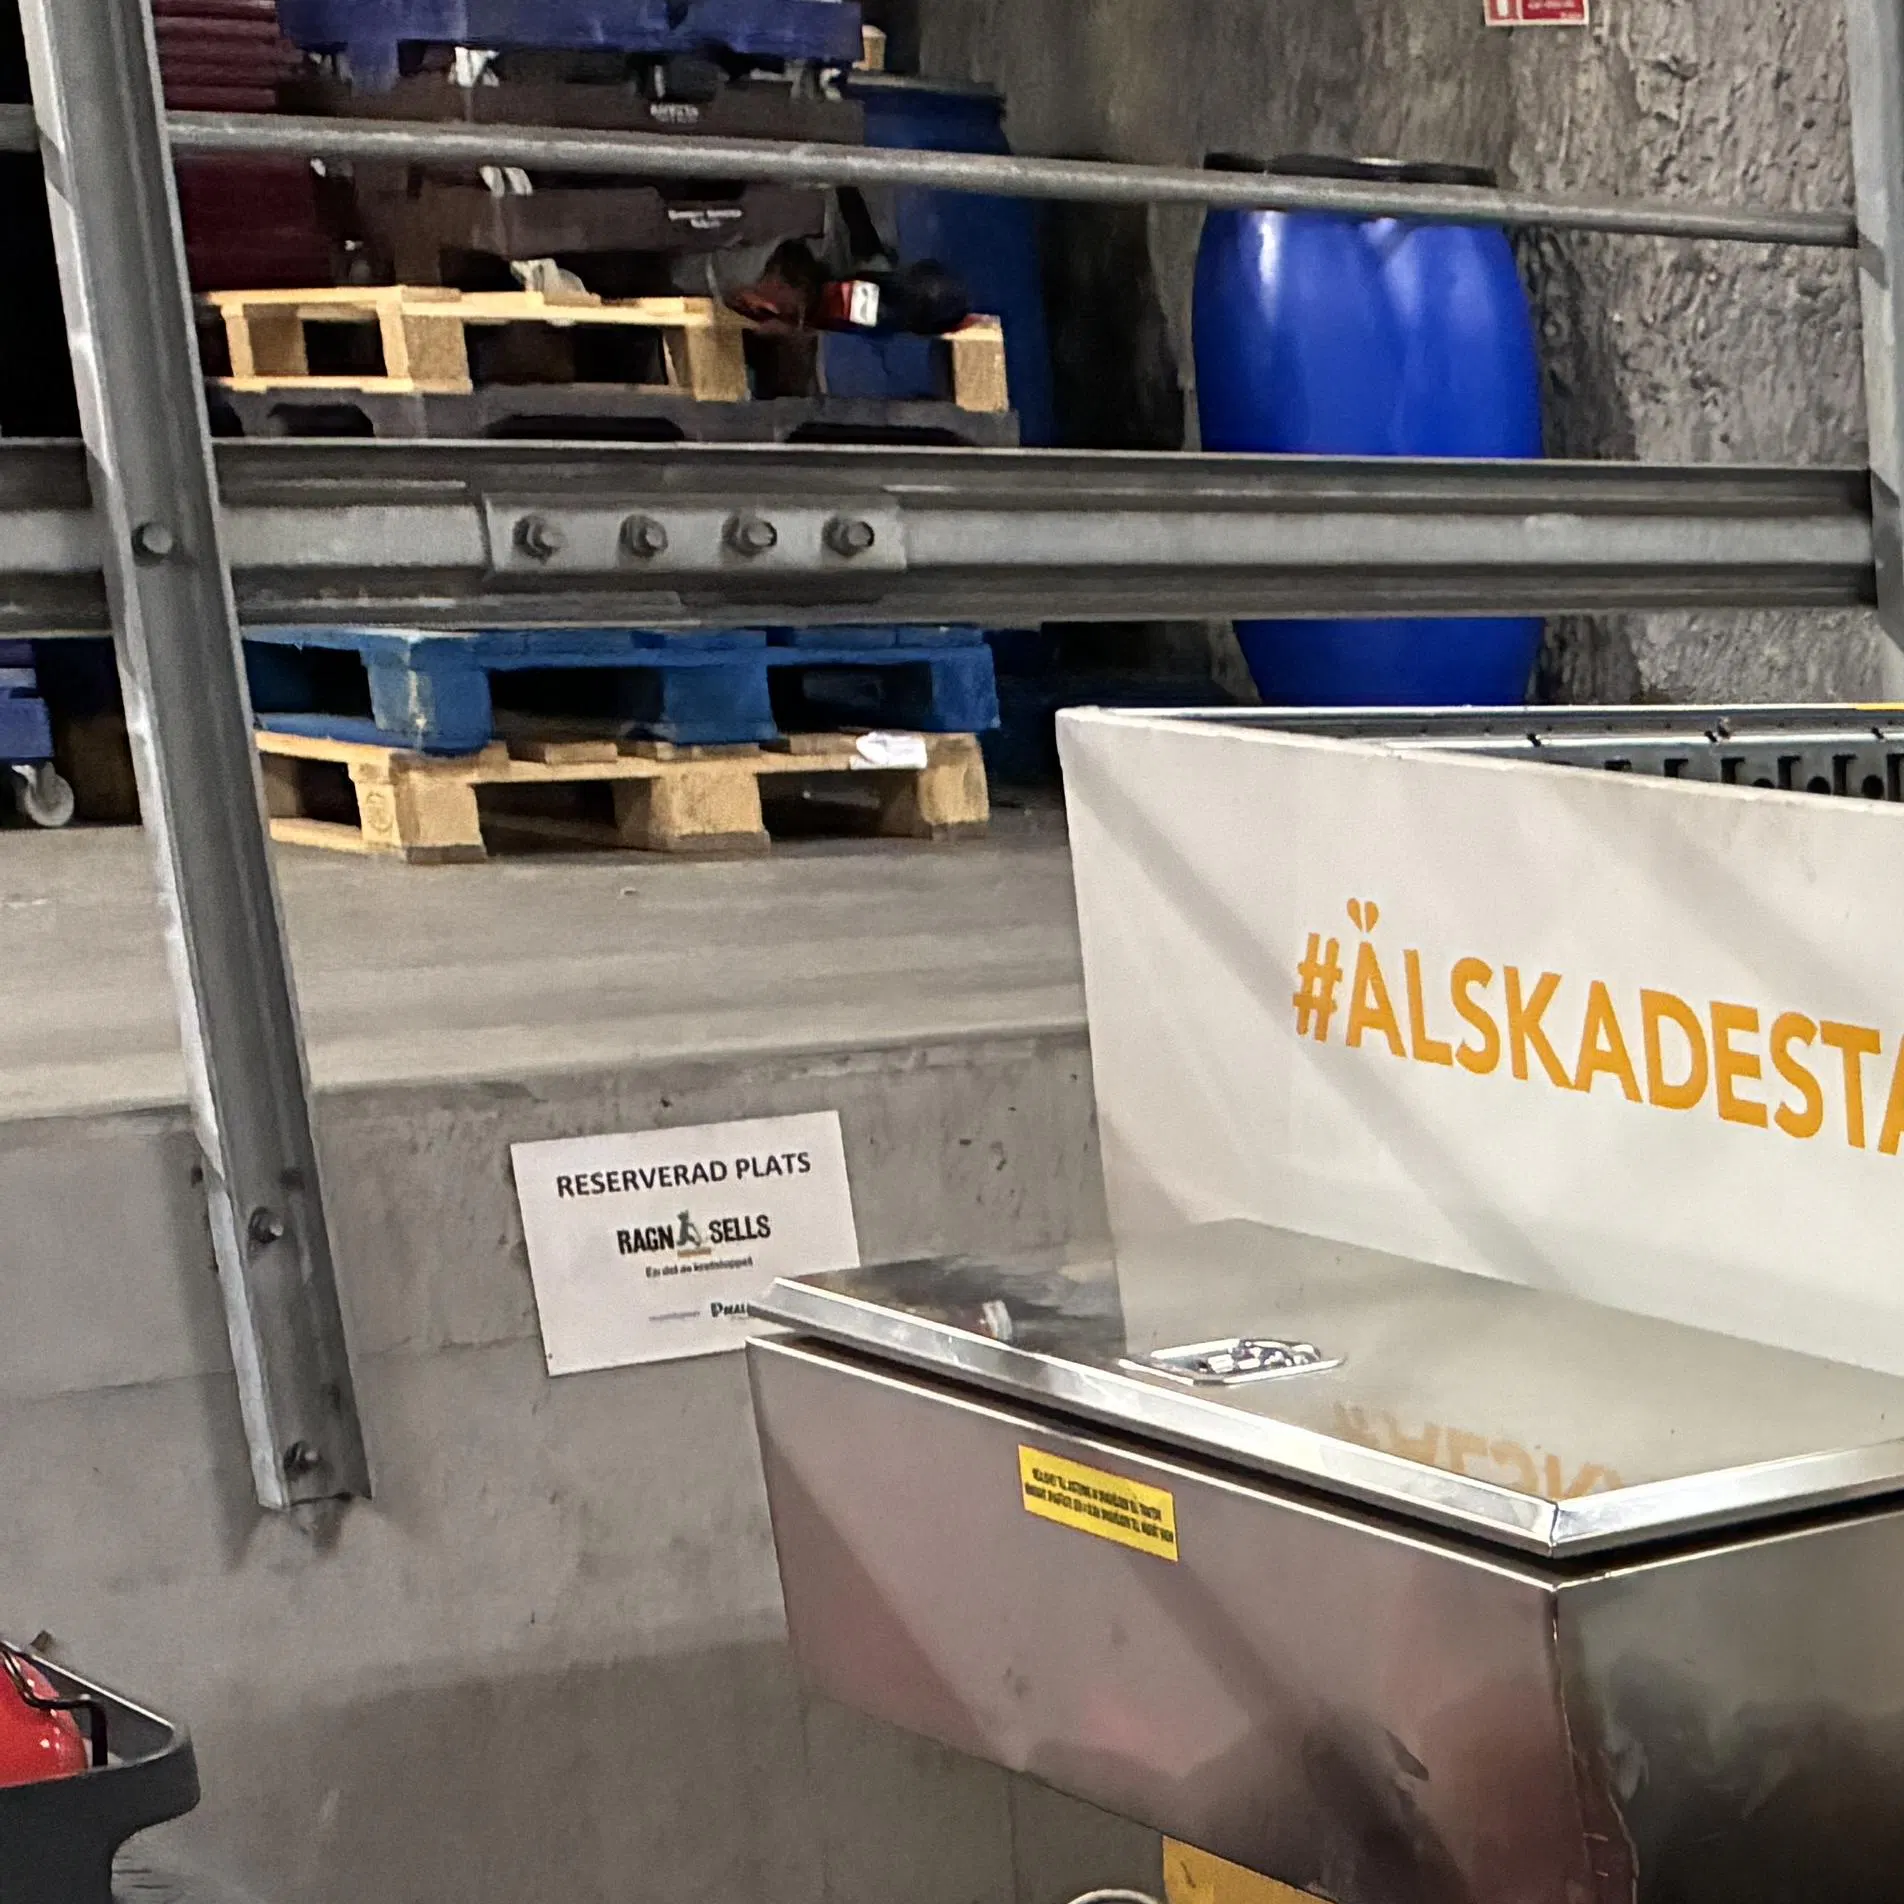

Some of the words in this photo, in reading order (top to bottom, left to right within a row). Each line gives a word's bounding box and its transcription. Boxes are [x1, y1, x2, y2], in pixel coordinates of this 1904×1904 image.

[556, 1160, 728, 1198] RESERVERAD
[735, 1151, 812, 1180] PLATS
[616, 1224, 675, 1256] RAGN
[708, 1214, 772, 1244] SELLS
